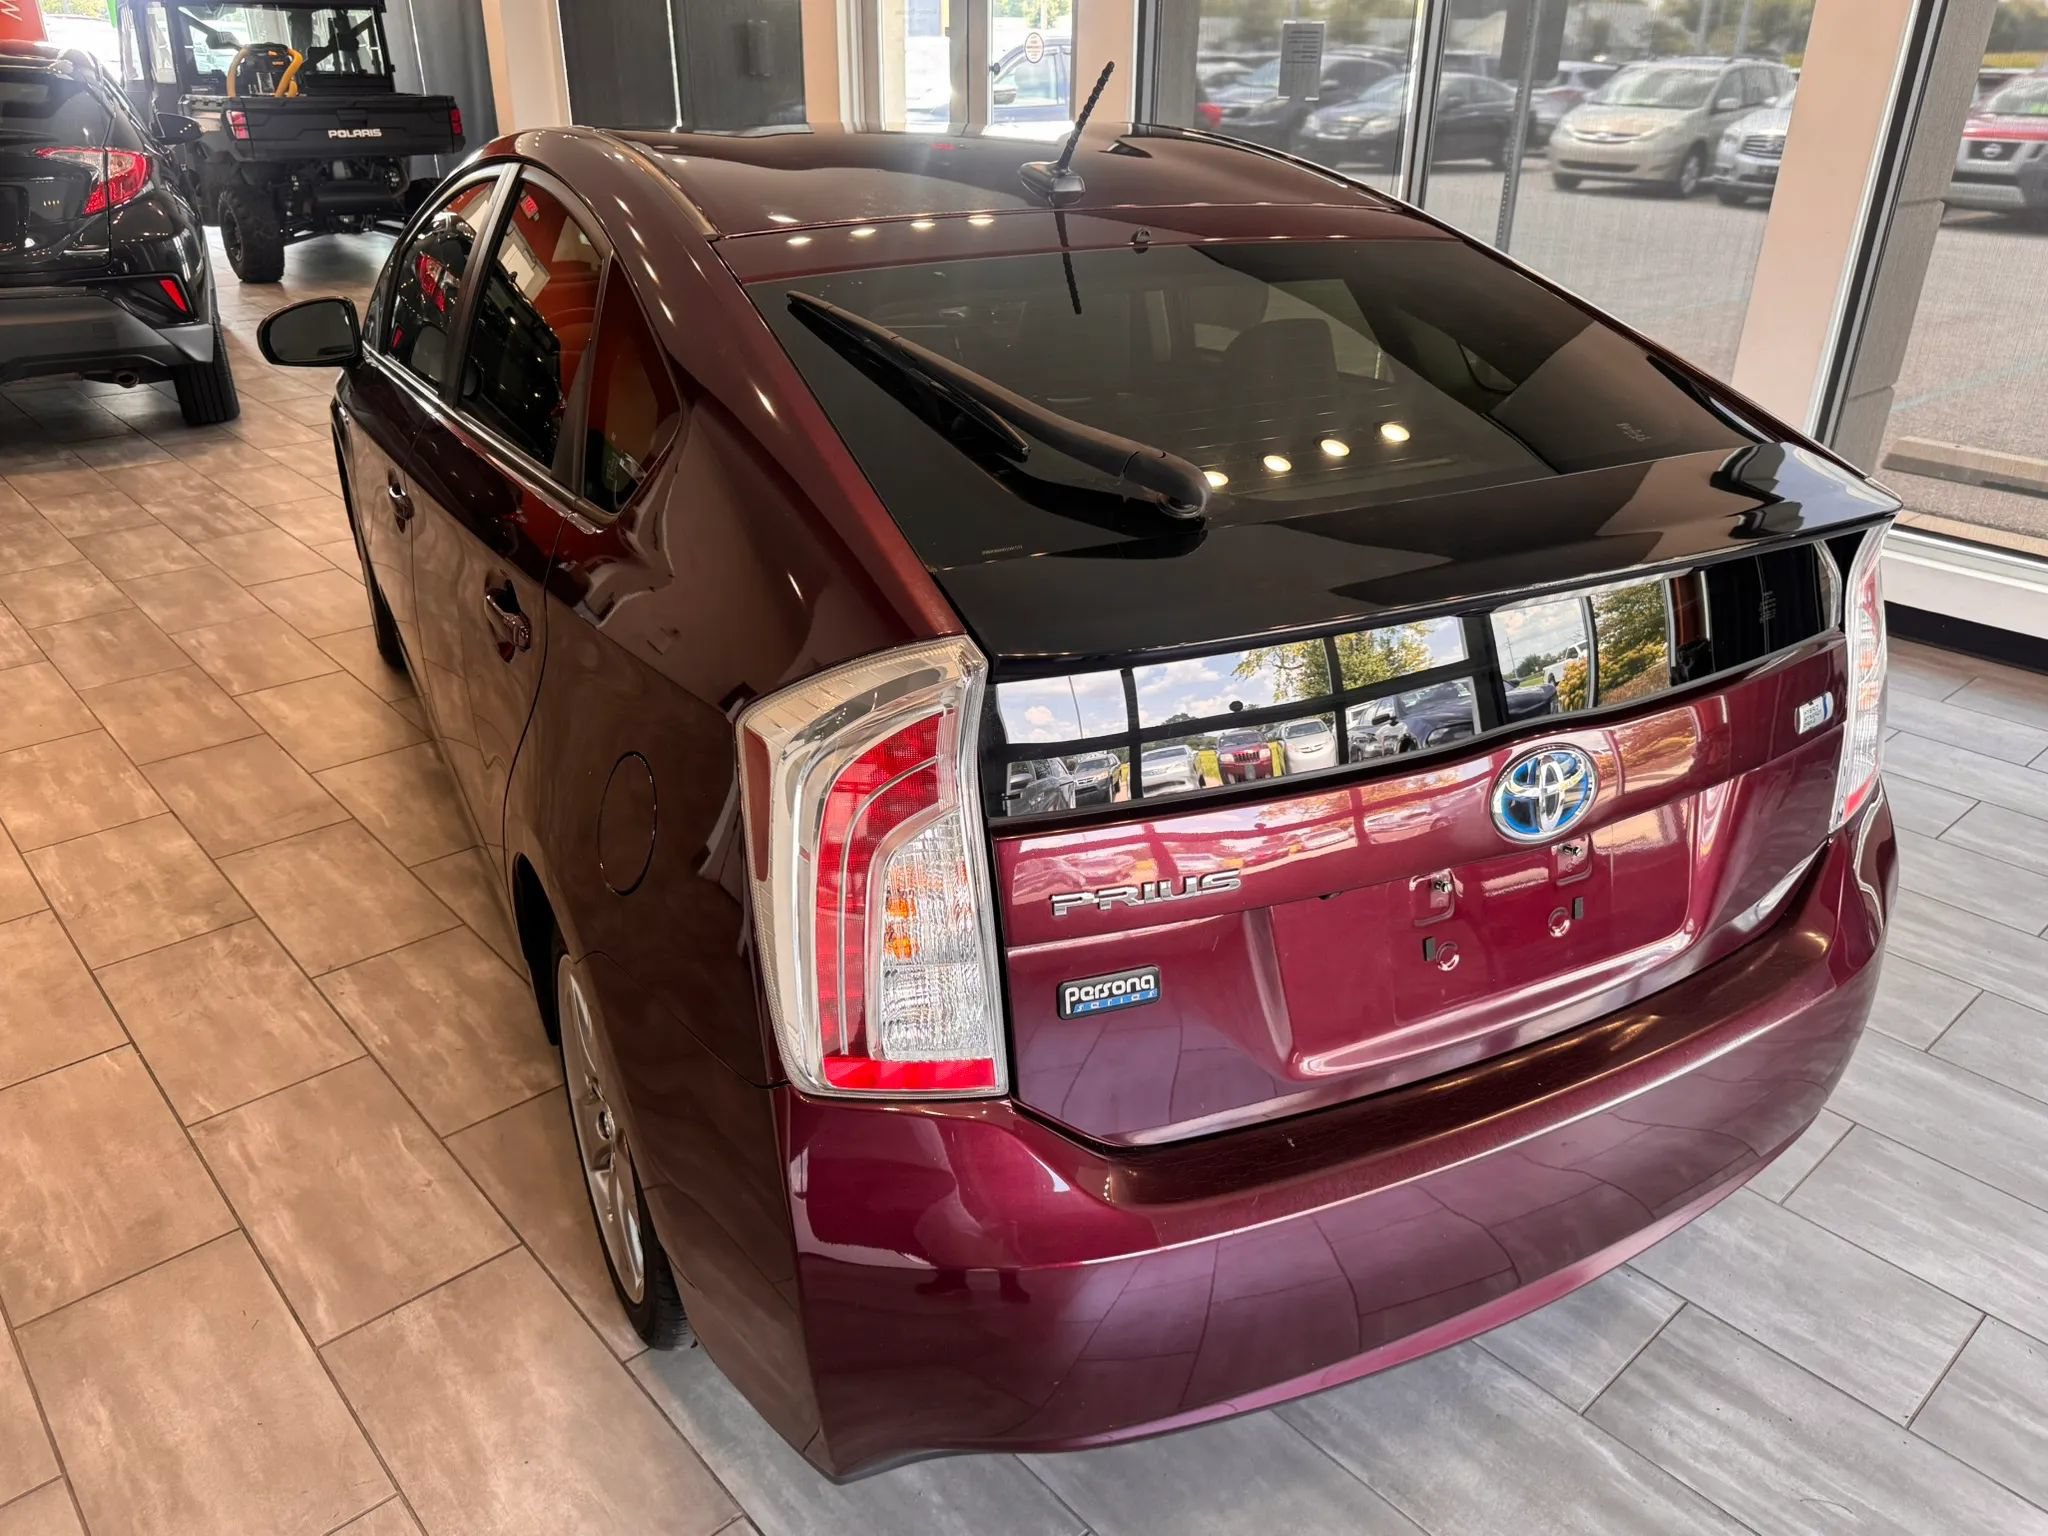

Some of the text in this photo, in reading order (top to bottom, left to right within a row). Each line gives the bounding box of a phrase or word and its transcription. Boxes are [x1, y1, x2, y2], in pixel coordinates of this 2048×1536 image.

[327, 128, 382, 139] POLARIS
[1050, 868, 1241, 916] PRIUS
[1064, 974, 1155, 1015] persona
